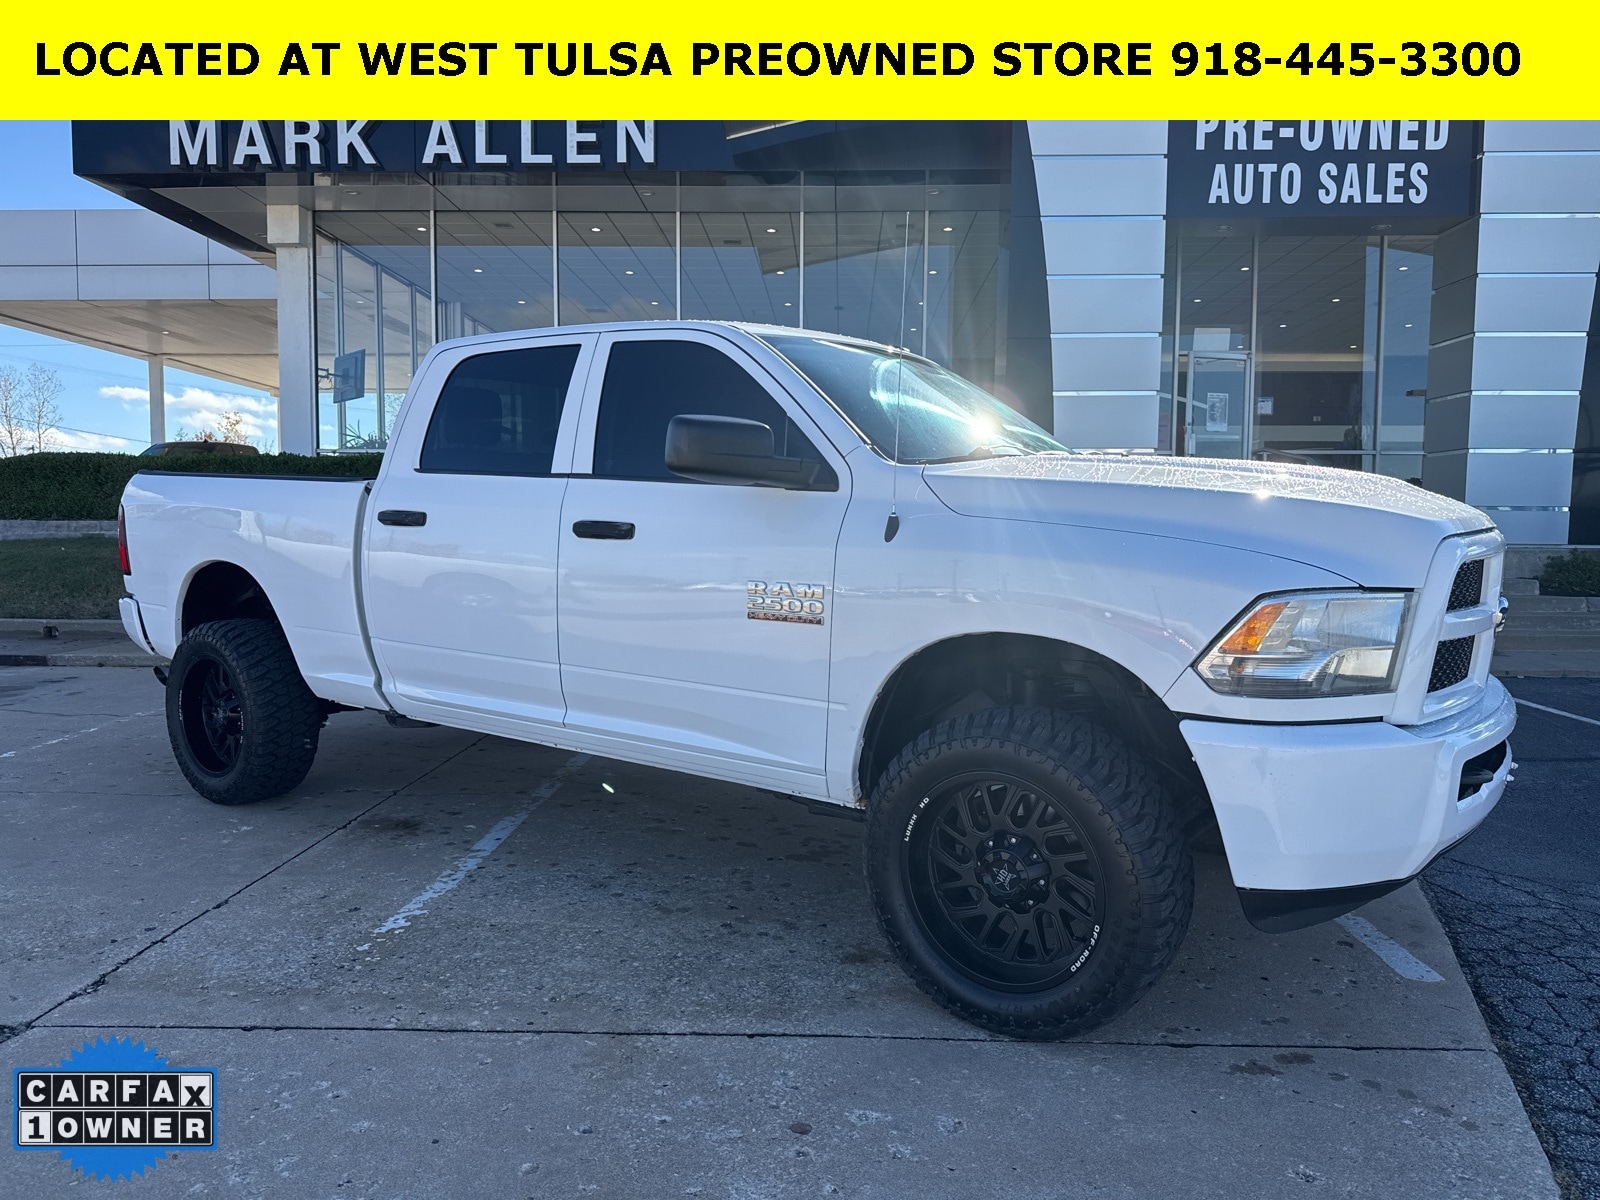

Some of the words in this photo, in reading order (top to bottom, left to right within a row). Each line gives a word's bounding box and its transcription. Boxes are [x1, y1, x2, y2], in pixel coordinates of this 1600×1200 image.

[169, 120, 378, 166] MARK
[422, 120, 655, 164] ALLEN
[1195, 120, 1450, 151] PRE-OWNED
[1208, 162, 1302, 205] AUTO
[1318, 162, 1429, 205] SALES
[747, 580, 825, 600] RAM
[747, 595, 825, 615] 2500
[1070, 924, 1100, 972] OFF-ROAD
